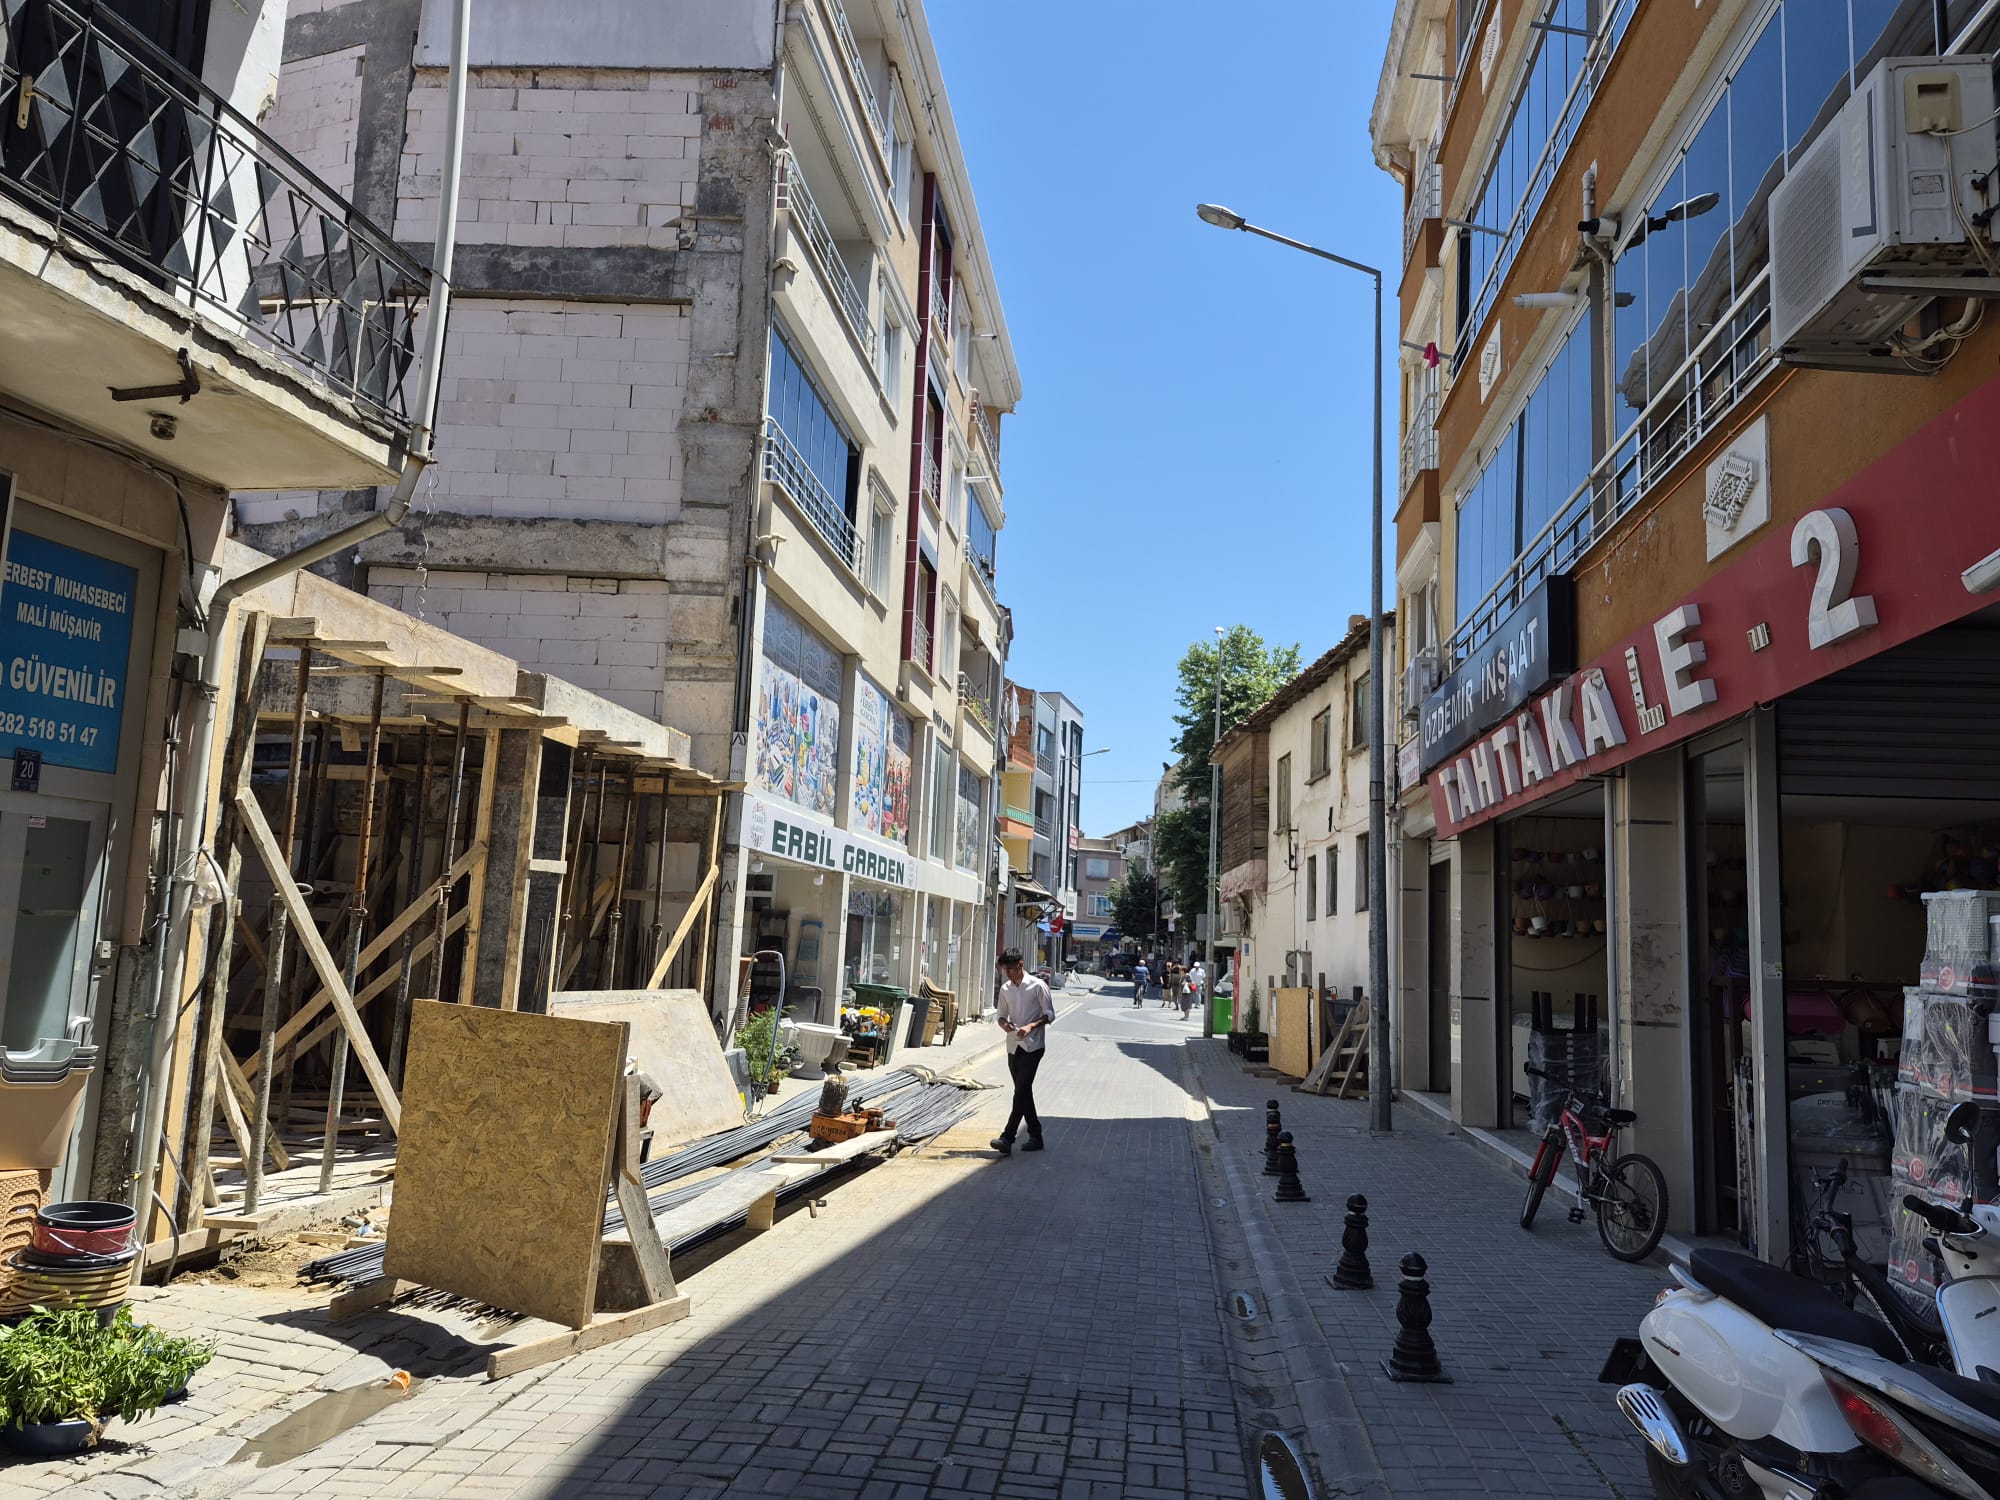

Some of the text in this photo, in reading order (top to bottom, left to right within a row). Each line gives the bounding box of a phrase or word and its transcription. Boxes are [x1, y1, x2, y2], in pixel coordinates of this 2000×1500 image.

[54, 575, 127, 614] MUHASEBECİ
[16, 601, 102, 642] MALİ MÜŞAVİR
[10, 653, 116, 709] GÜVENİLİR
[1439, 603, 1719, 825] TAHTAKALE
[1791, 507, 1879, 651] 2
[1481, 616, 1538, 705] İNŞAAT
[28, 716, 56, 741] 518
[59, 722, 76, 744] 51
[79, 726, 98, 747] 47
[20, 760, 34, 779] 20
[772, 819, 836, 868] ERBİL
[843, 844, 905, 886] GARDEN
